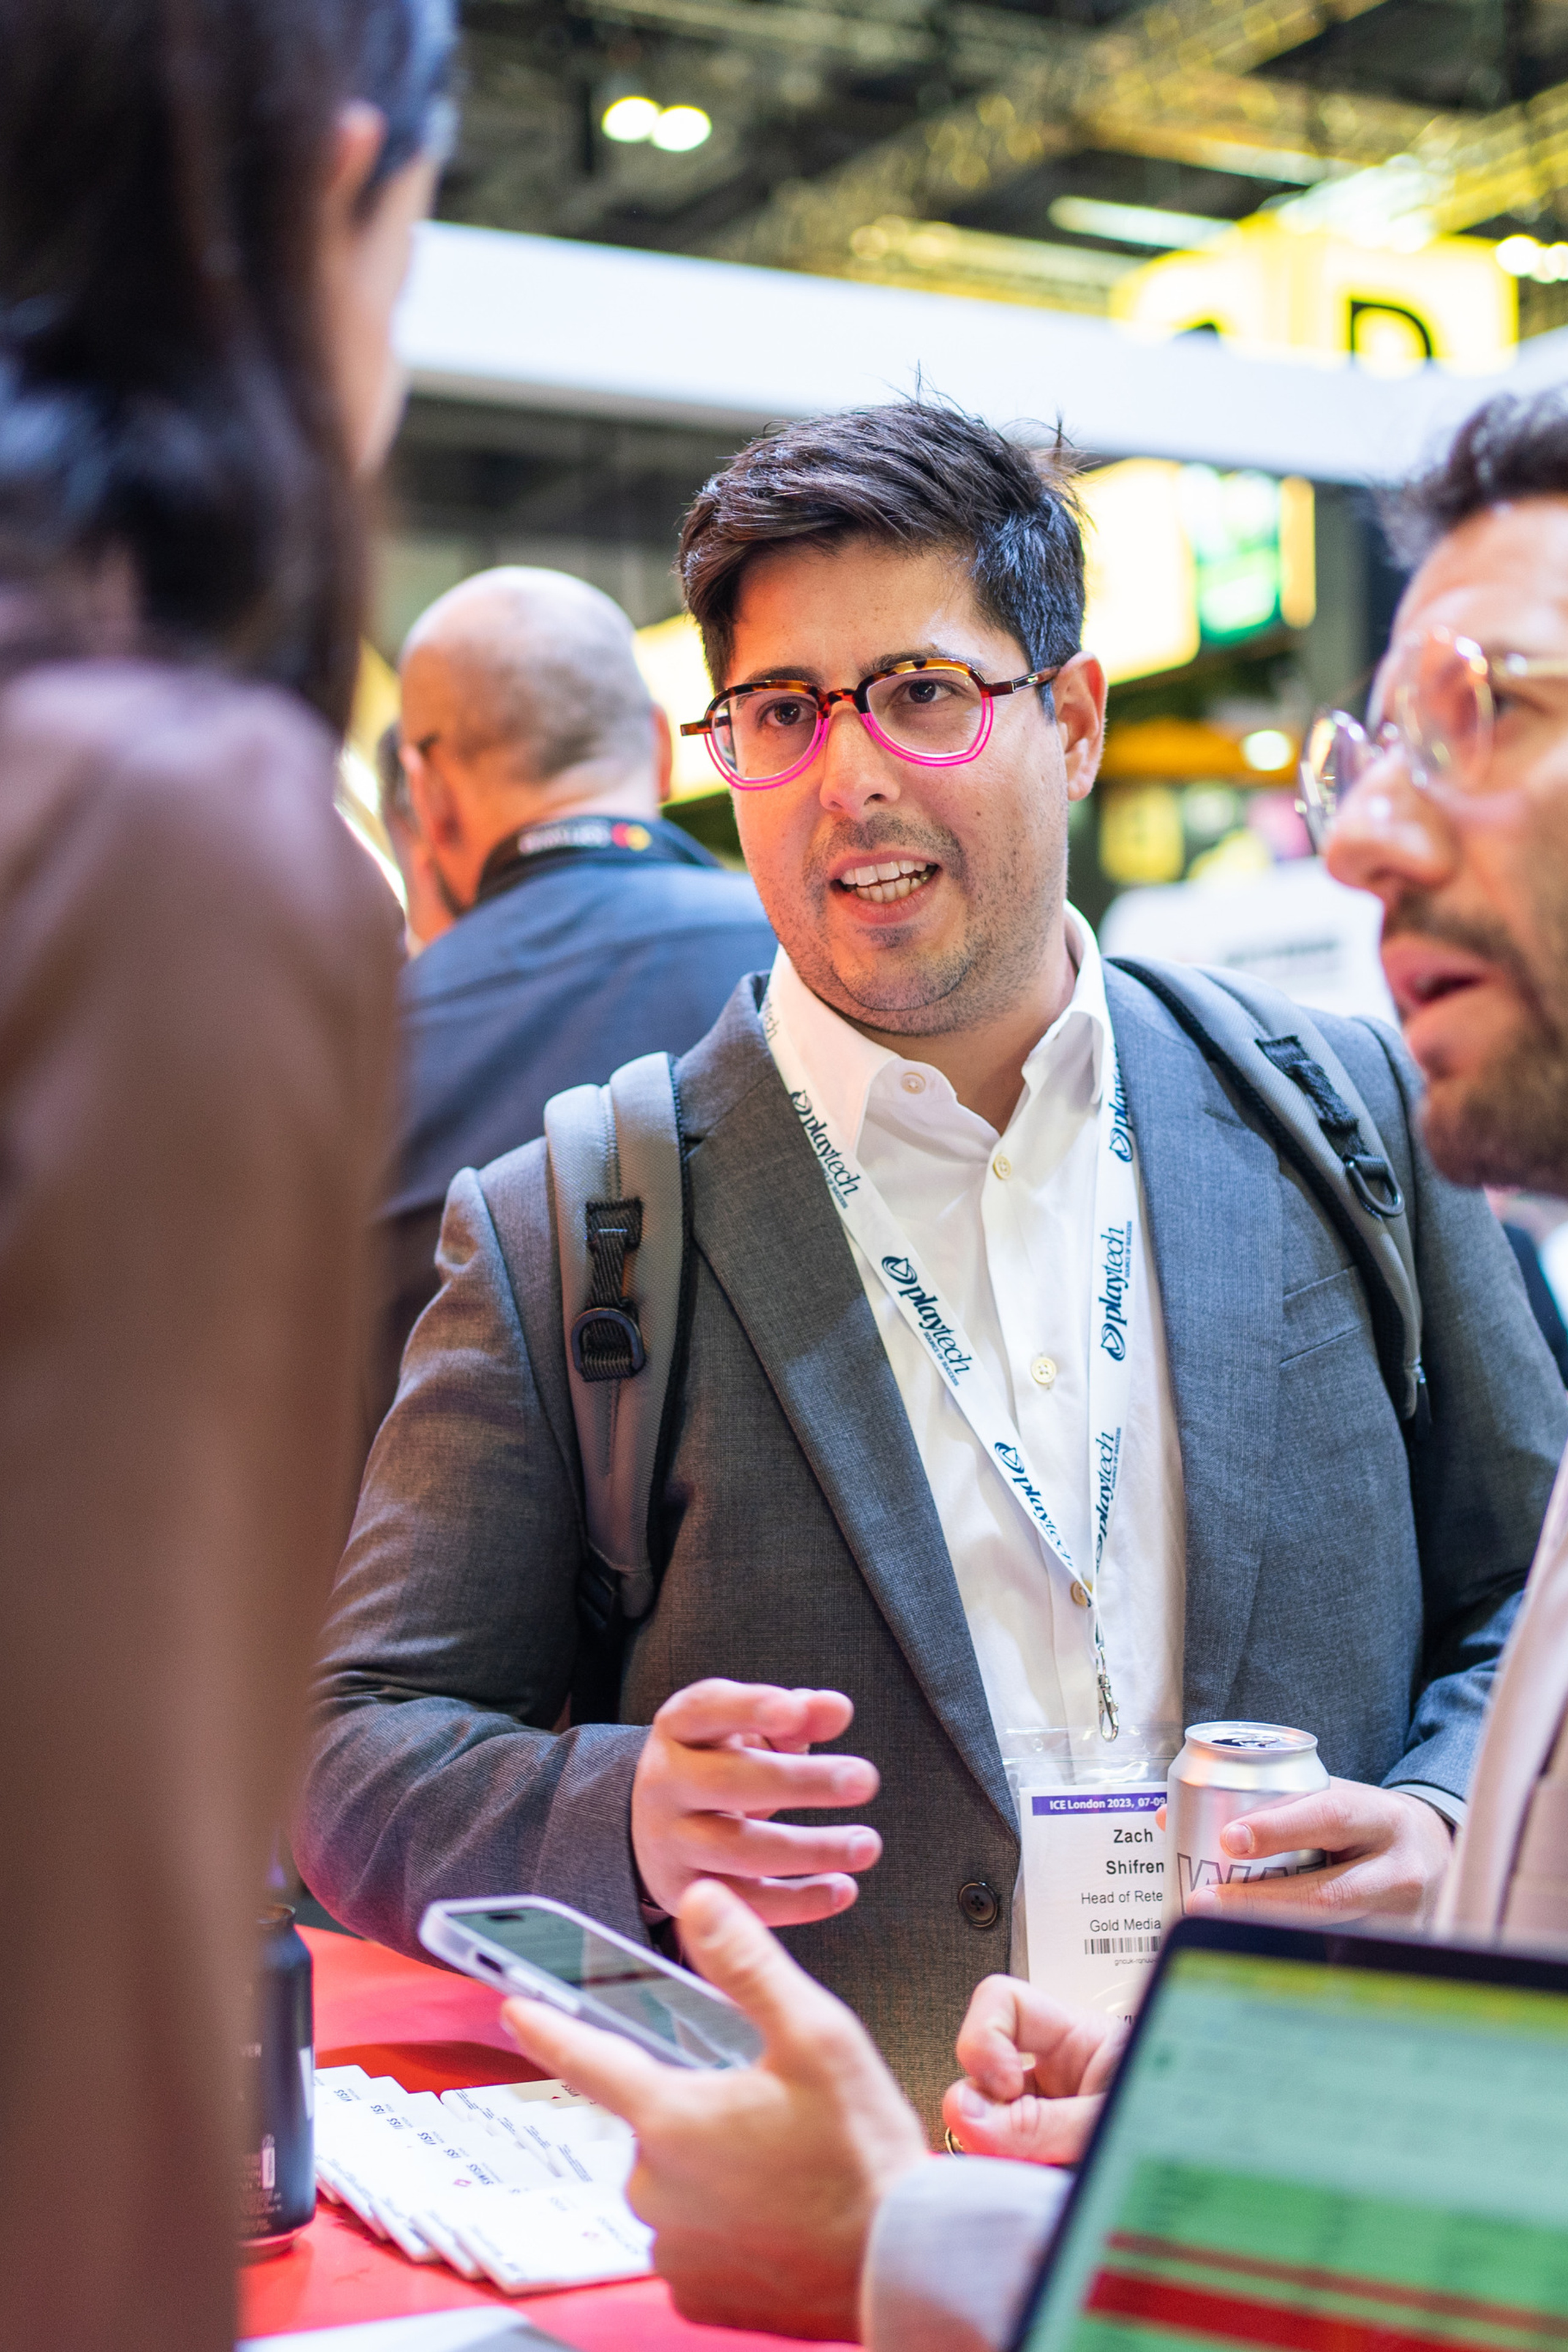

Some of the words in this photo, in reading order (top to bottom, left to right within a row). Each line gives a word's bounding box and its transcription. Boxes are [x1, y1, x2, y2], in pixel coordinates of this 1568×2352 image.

[803, 1115, 861, 1196] playtech
[1098, 1227, 1128, 1327] playtech
[897, 1284, 973, 1375] playtech
[923, 1332, 940, 1353] SOURCE
[941, 1361, 959, 1387] SUCCESS
[1095, 1431, 1114, 1540] playtech
[1049, 1800, 1066, 1810] ICE
[1068, 1799, 1106, 1809] London
[1107, 1798, 1135, 1808] 2023,
[1114, 1828, 1153, 1843] Zach
[1106, 1860, 1164, 1875] Shifren
[1081, 1891, 1114, 1904] Head
[1118, 1891, 1131, 1902] of
[1134, 1890, 1163, 1902] Rete
[1090, 1919, 1119, 1932] Gold
[1124, 1918, 1161, 1930] Media
